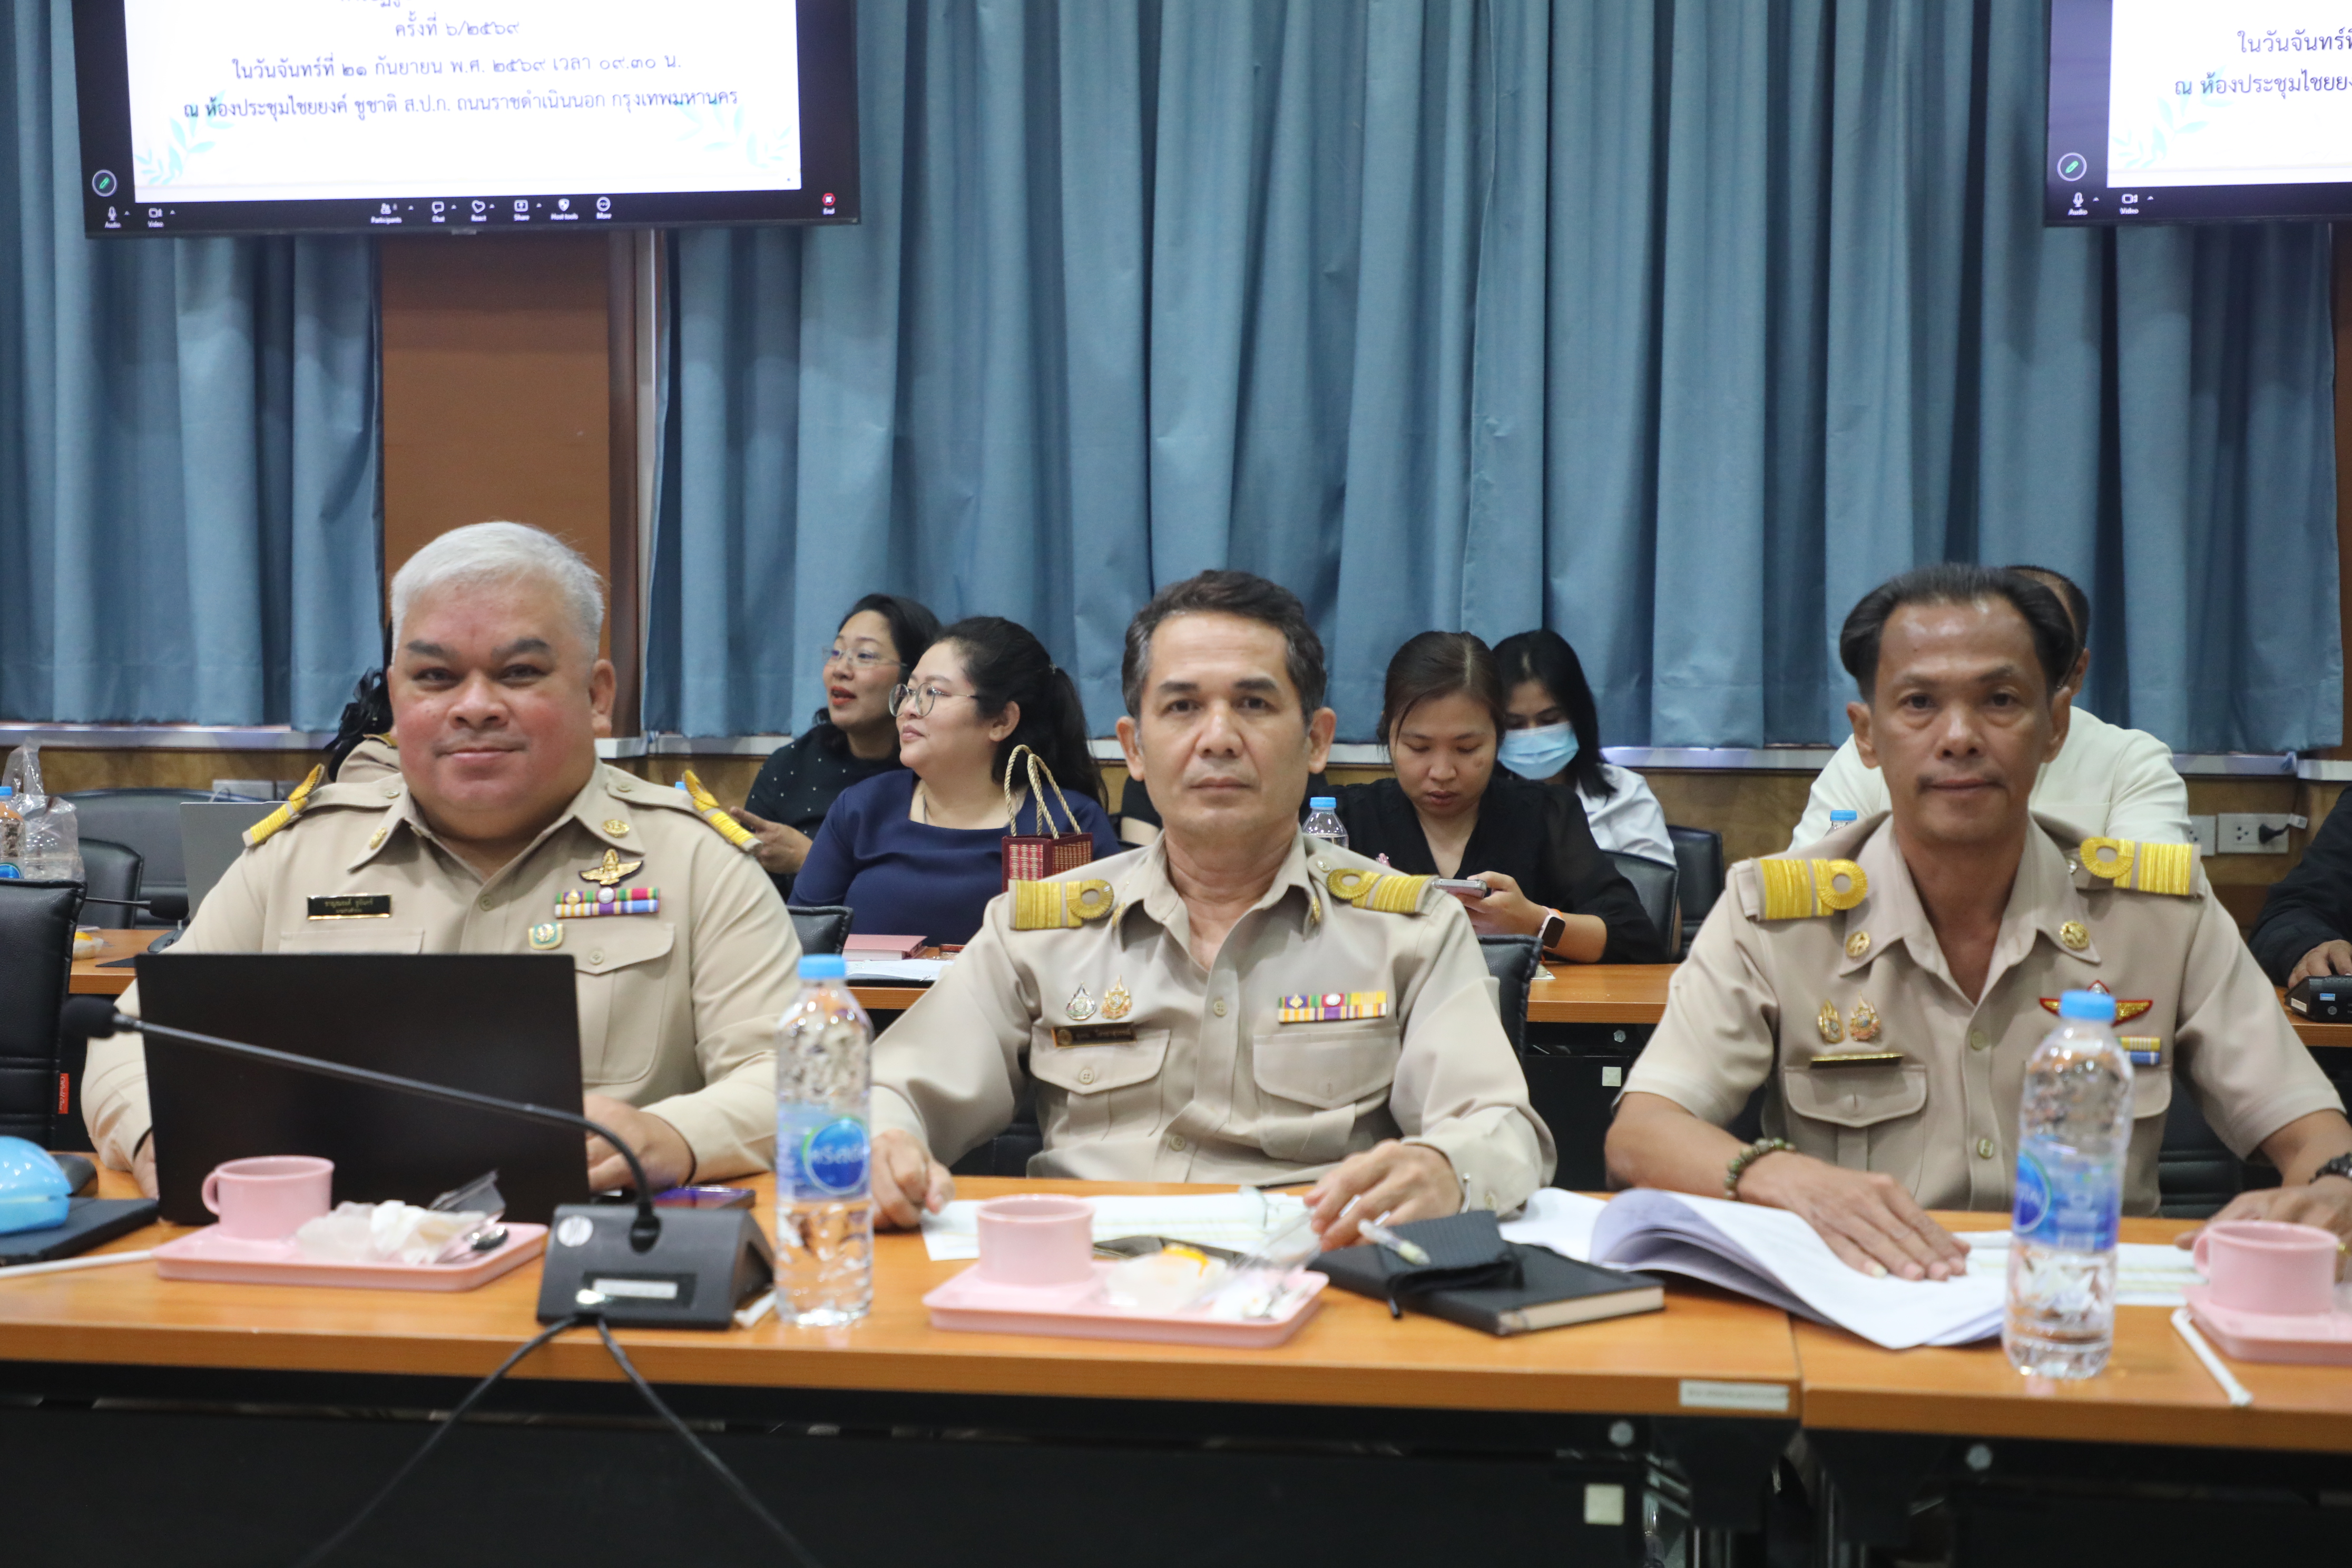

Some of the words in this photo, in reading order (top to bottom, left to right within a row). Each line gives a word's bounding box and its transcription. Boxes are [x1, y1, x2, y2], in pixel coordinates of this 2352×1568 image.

[395, 11, 437, 36] ครั้งที่
[445, 20, 520, 36] ๖/๒๕๖๙
[231, 53, 334, 79] ในวันจันทร์ที่
[342, 63, 367, 76] ๒๑
[375, 55, 442, 75] กันยายน
[450, 59, 484, 73] พ.ศ.
[493, 58, 545, 72] ๒๕๖๙
[553, 56, 591, 71] เวลา
[600, 58, 656, 70] ๐๙.๓๐
[664, 55, 681, 68] น.
[2175, 80, 2192, 95] ณ
[184, 104, 199, 117] ณ
[205, 93, 348, 122] ห้องประชุมไชยยงค์
[355, 94, 397, 121] ชูชาติ
[405, 97, 450, 112] ส.ป.ก.
[457, 90, 605, 111] ถนนราชดำเนินนอก
[612, 91, 738, 112] กรุงเทพมหานคร
